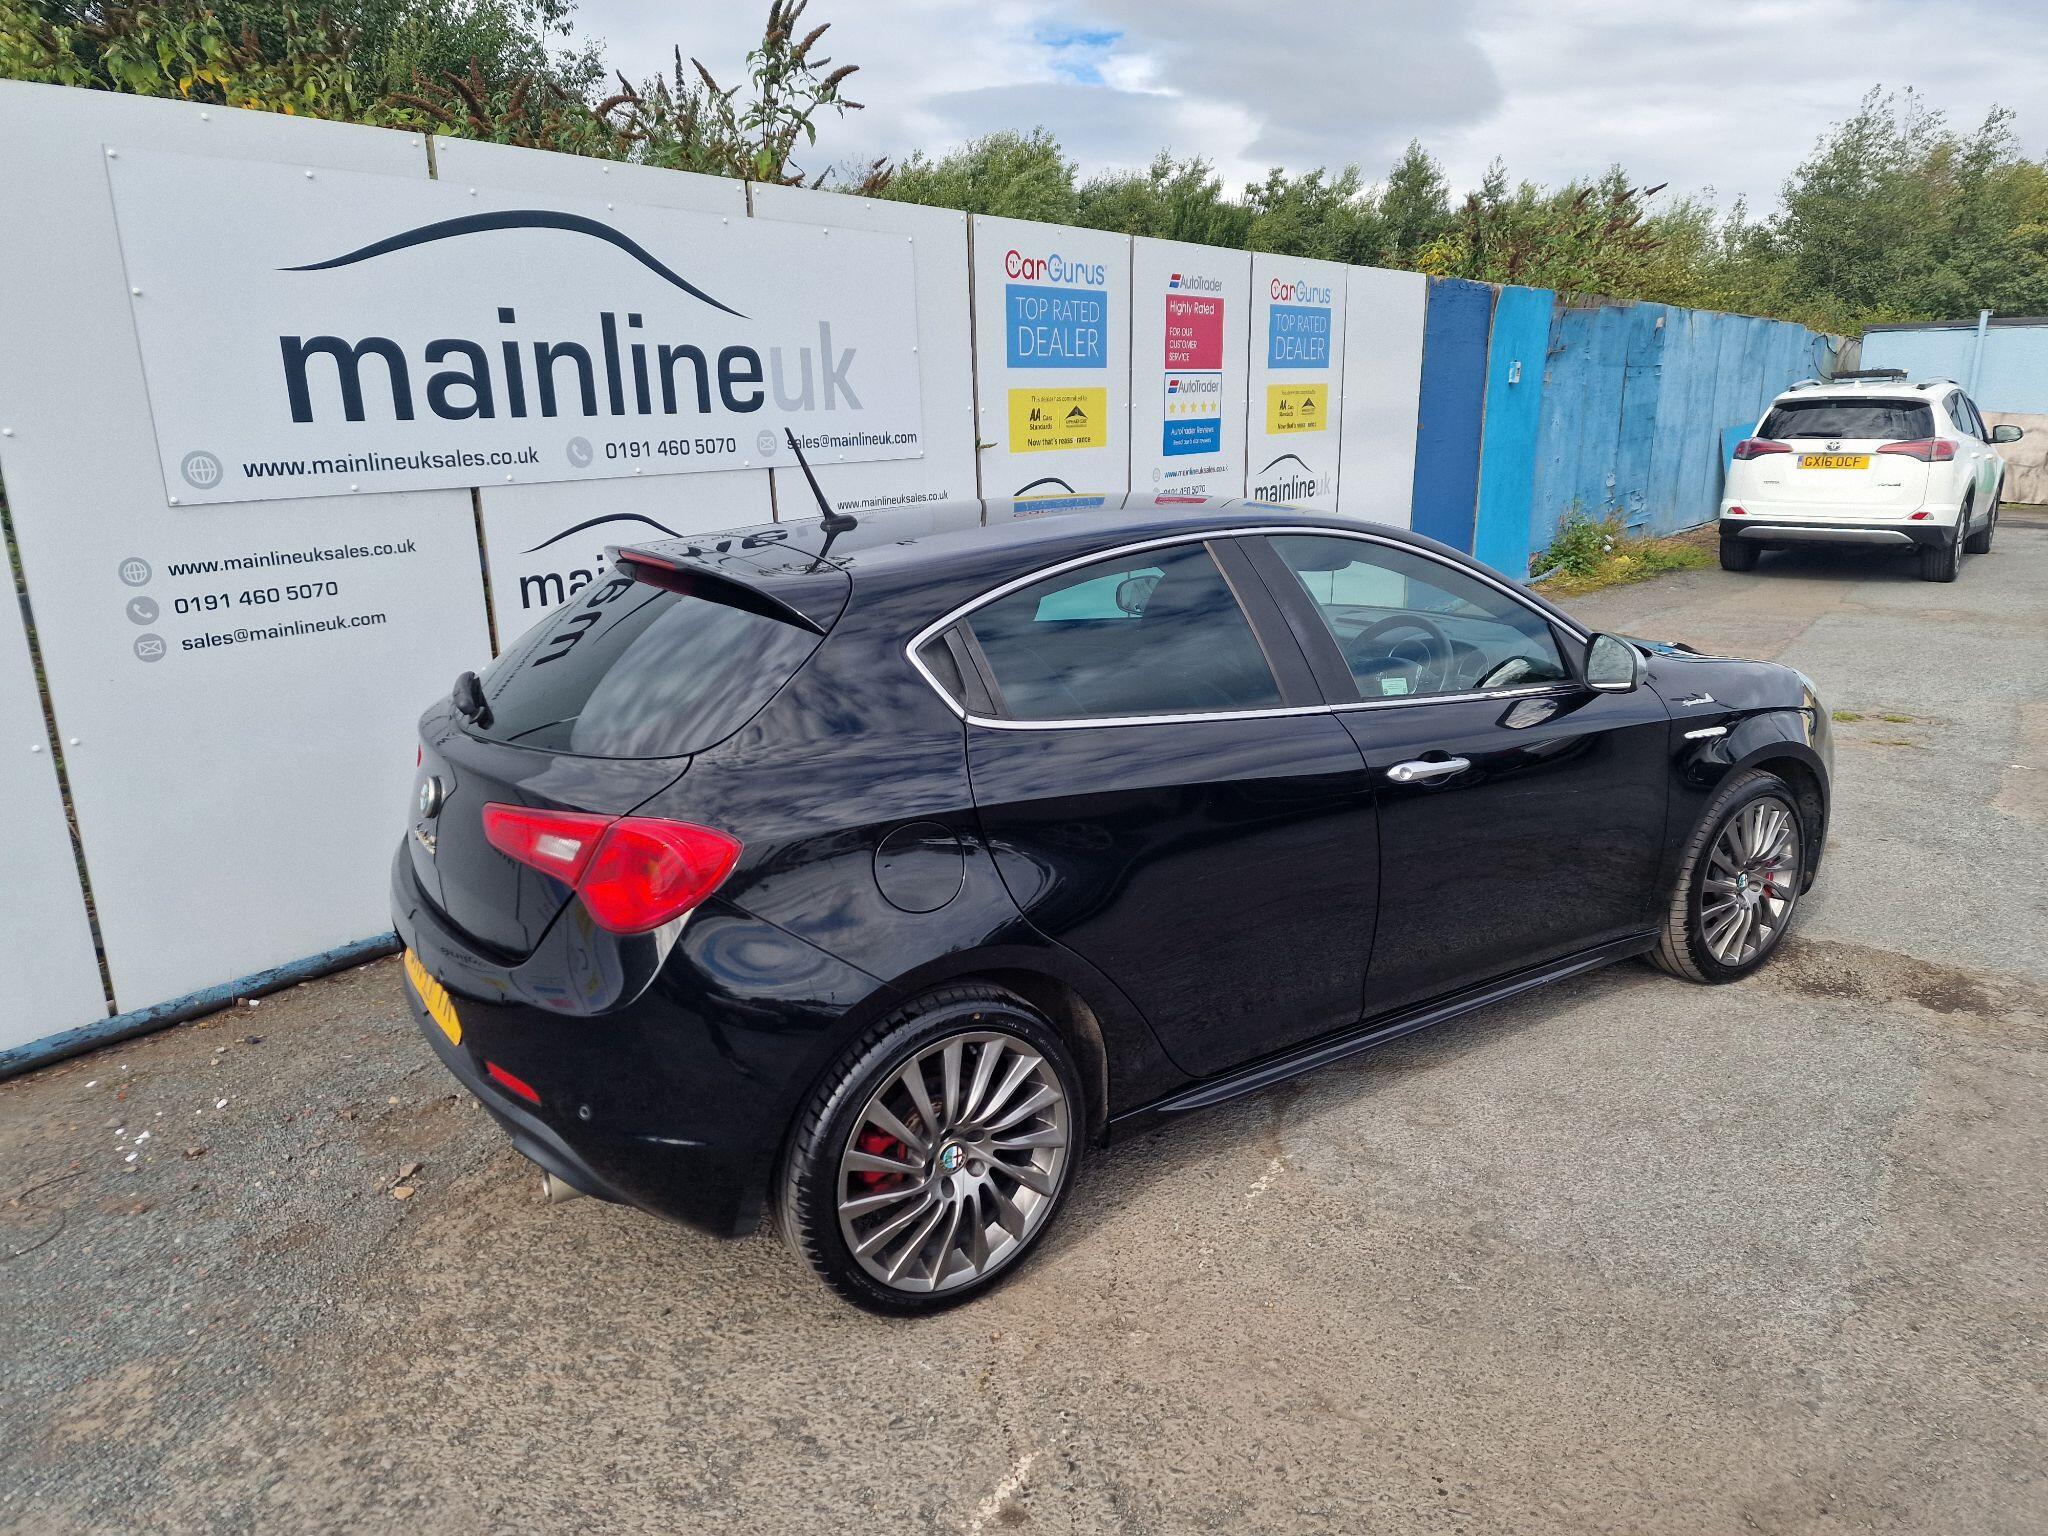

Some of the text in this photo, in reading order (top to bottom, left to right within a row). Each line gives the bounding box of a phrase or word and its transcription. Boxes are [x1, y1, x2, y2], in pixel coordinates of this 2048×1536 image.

[1005, 250, 1105, 285] CarGurus
[1180, 274, 1222, 292] AutoTrader
[1270, 278, 1331, 304] CarGurus
[1015, 296, 1100, 323] TOP RATED
[1169, 300, 1215, 316] Highly Rated
[1169, 327, 1193, 337] FOR OUR
[1275, 313, 1327, 333] TOP RATED
[1018, 326, 1099, 357] DEALER
[1169, 340, 1198, 350] CUSTOMER
[1275, 336, 1325, 360] DEALER
[279, 307, 863, 423] mainlineuk
[1168, 352, 1190, 362] SERVICE
[1178, 379, 1219, 393] AutoTrader
[605, 437, 737, 459] 0191 460 5070
[787, 430, 918, 450] sales@mainlineuk.com
[1058, 436, 1091, 445] reassrance
[242, 446, 540, 478] www.mainlineuksales.co.uk
[1805, 456, 1861, 467] GX16 OCF
[837, 490, 949, 511] www.mainlineuksales.co.uk
[168, 539, 417, 577] www.mainlineuksales.co.uk
[174, 581, 339, 614] 0191 460 5070
[181, 612, 387, 651] sales@mainlineuk.com
